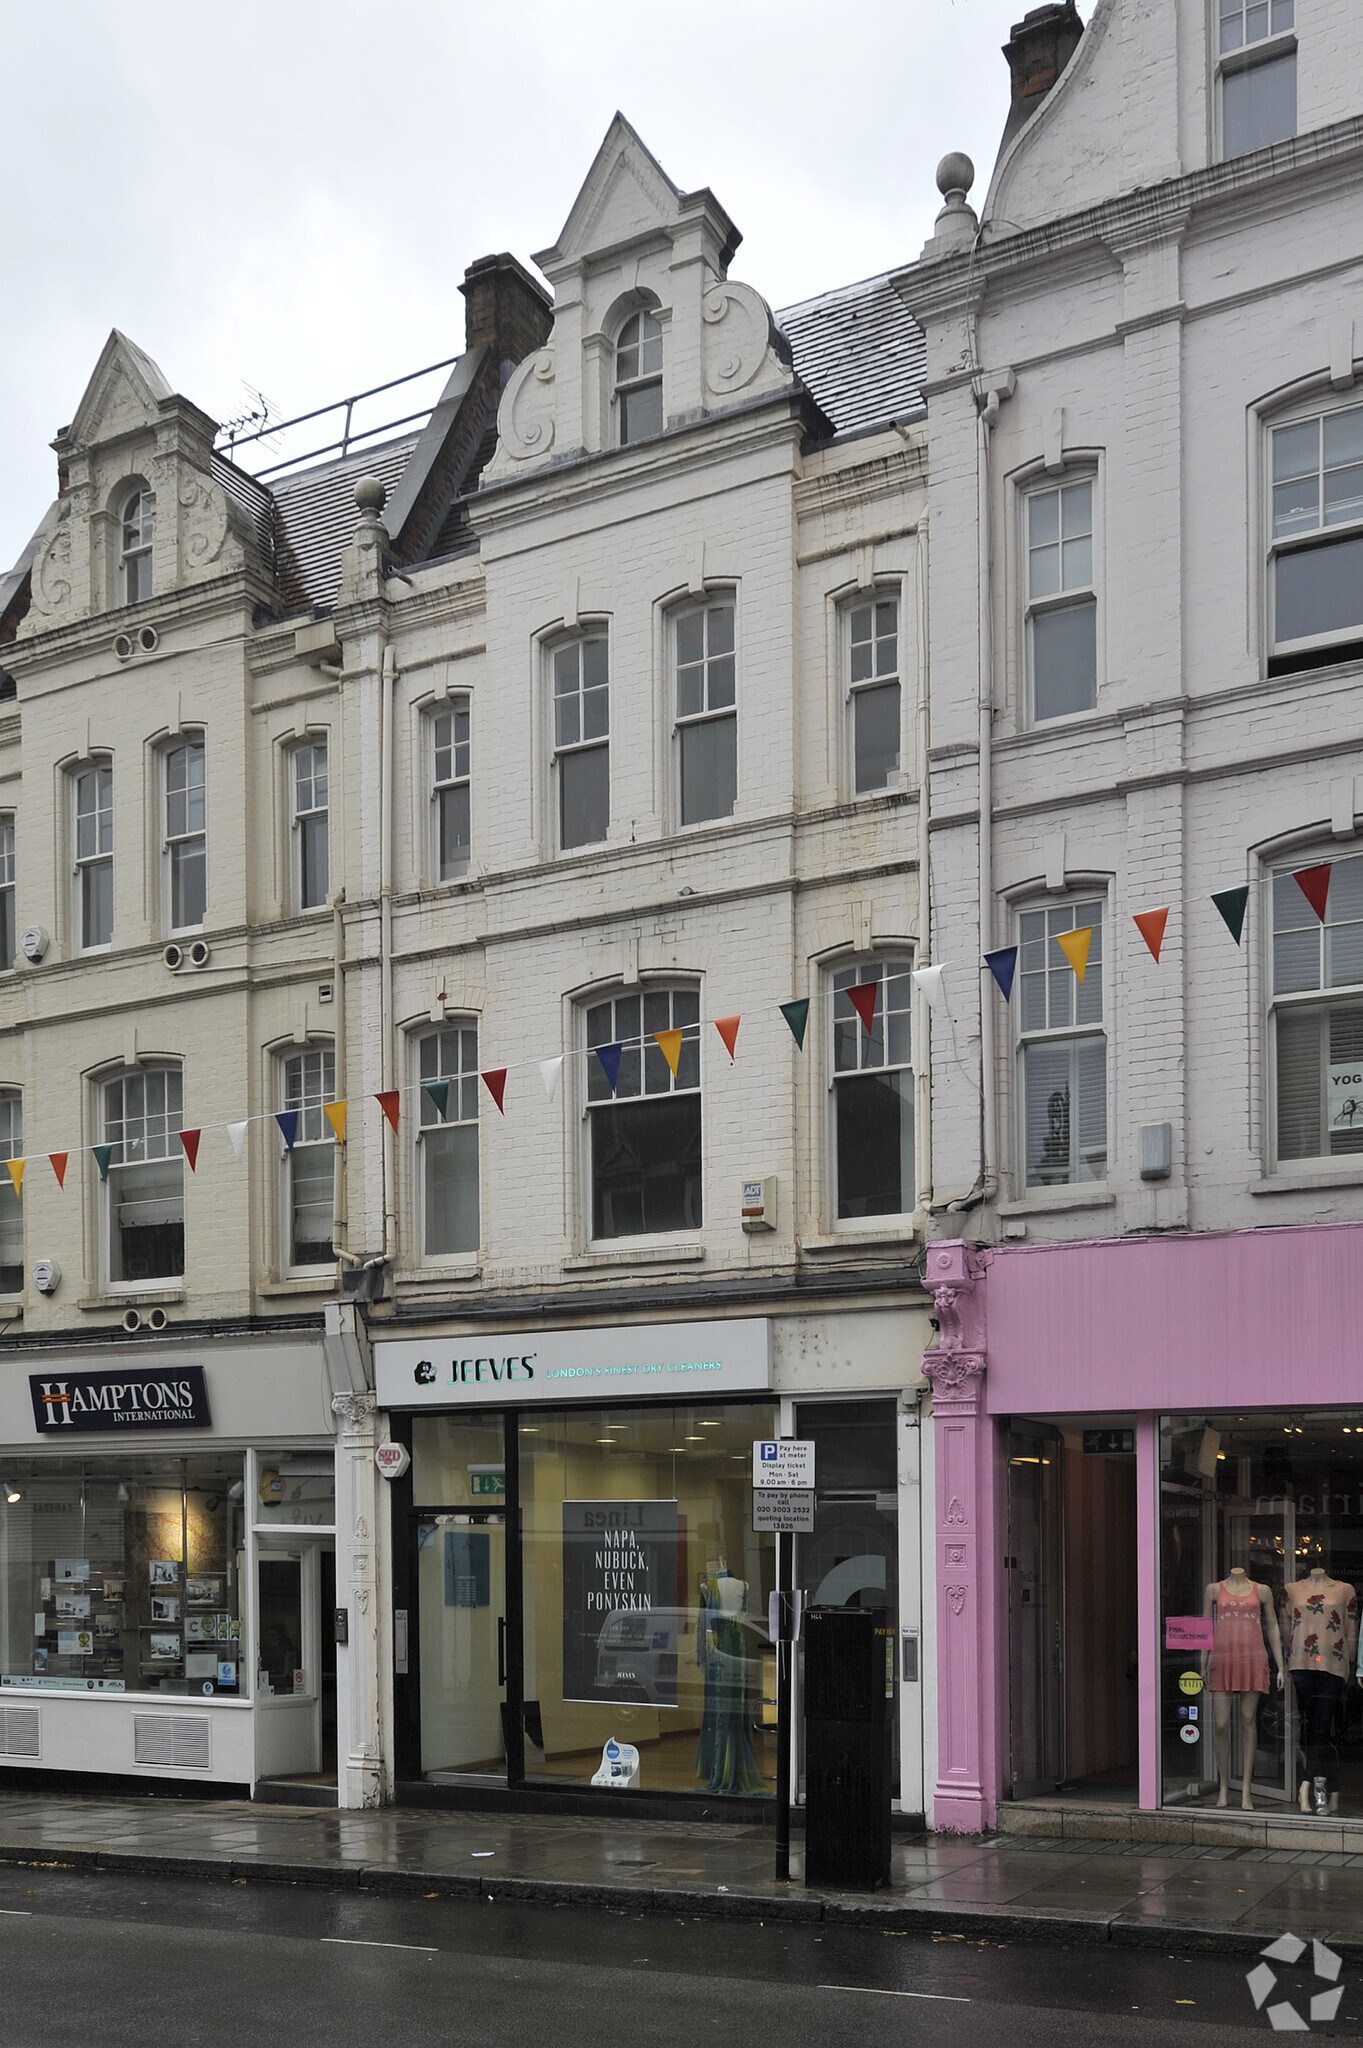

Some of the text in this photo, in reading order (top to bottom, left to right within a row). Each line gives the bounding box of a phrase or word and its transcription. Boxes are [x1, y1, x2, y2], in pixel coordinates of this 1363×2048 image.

[744, 1185, 761, 1196] ADT
[448, 1355, 723, 1385] JEEVES LONDON'S FINEST DRY CLEANERS
[40, 1381, 193, 1425] HAMPTONS
[113, 1409, 195, 1422] INTERNATIONAL
[604, 1530, 639, 1550] NAPA,
[595, 1551, 649, 1571] NUBUCK,
[604, 1571, 634, 1590] EVEN
[587, 1591, 651, 1611] PONYSKIN
